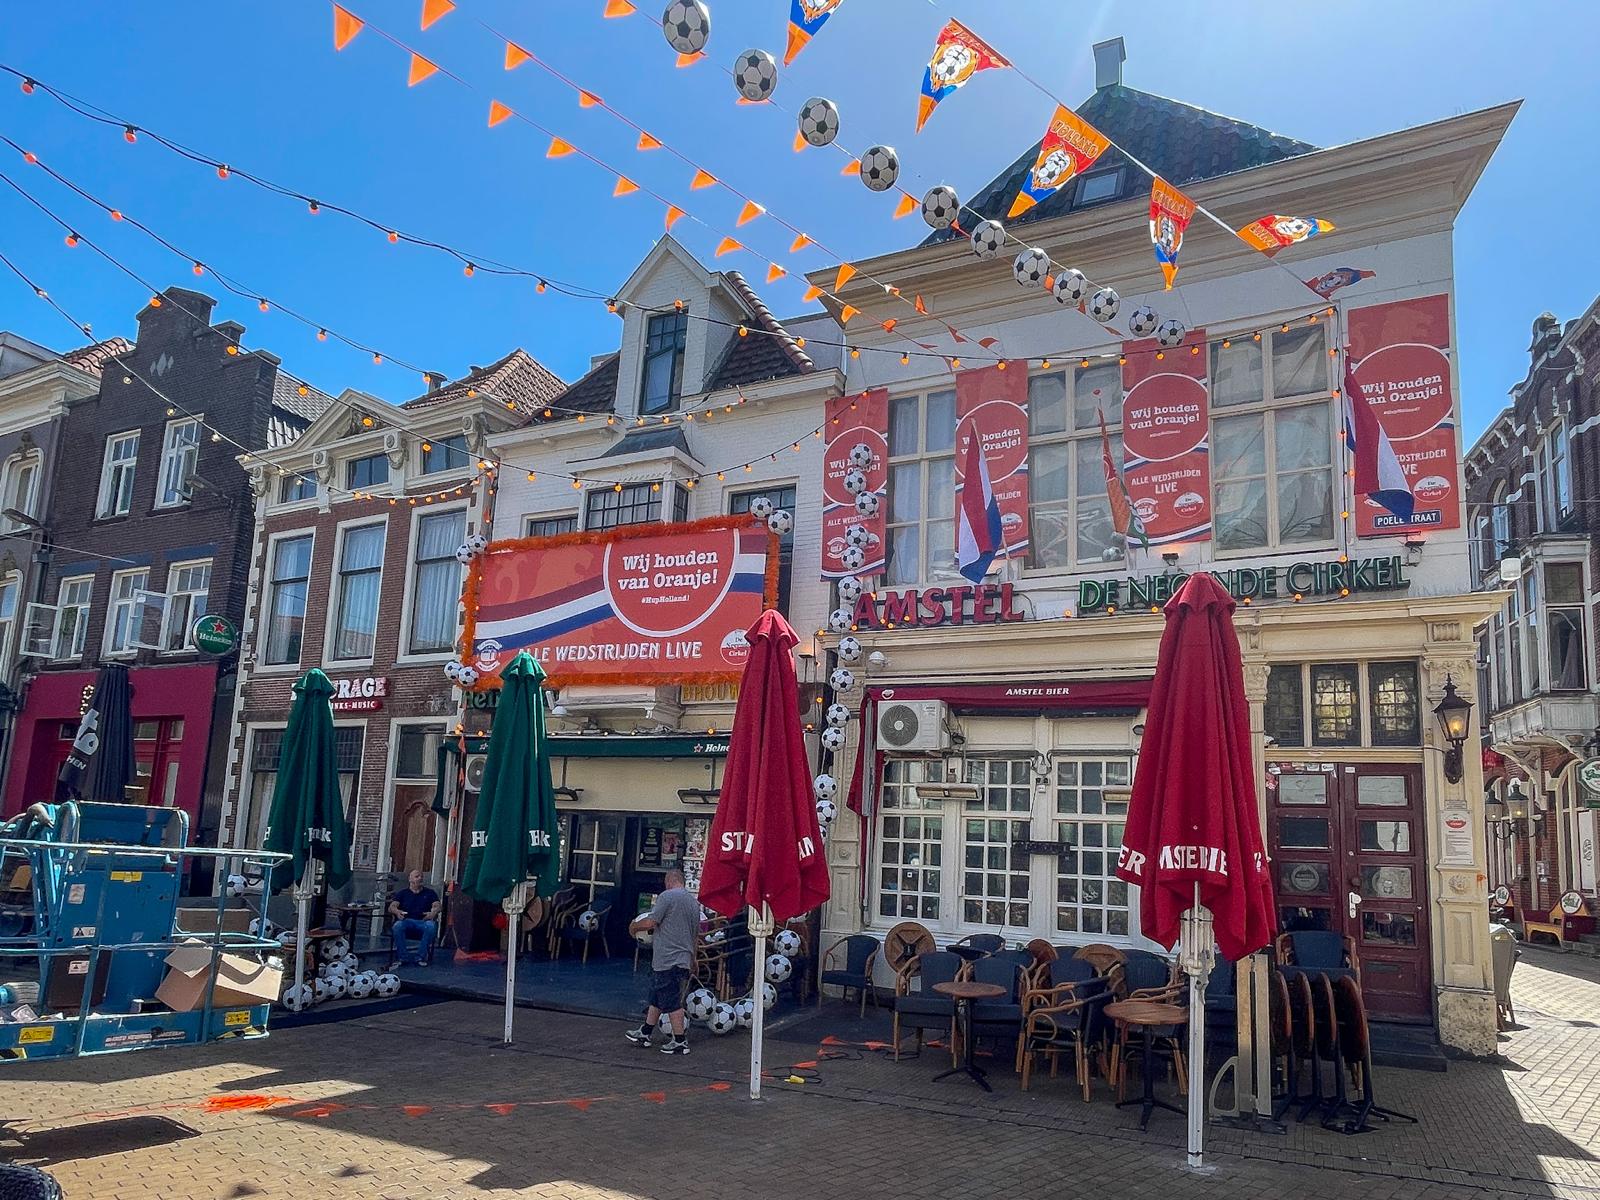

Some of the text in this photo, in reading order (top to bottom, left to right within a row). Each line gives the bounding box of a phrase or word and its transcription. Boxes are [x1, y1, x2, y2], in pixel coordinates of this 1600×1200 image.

[1360, 375, 1442, 394] Wij houden
[1390, 385, 1443, 402] Oranje!
[1130, 404, 1200, 419] Wij houden
[1129, 412, 1200, 430] van Oranje!
[981, 428, 1021, 442] houden
[982, 437, 1021, 451] Oranje!
[1397, 449, 1447, 462] DSTRIJDEN
[1402, 463, 1418, 475] VE
[1131, 469, 1201, 486] ALLE WEDSTRIJDEN
[1155, 481, 1178, 494] LIVE
[827, 519, 842, 527] ALLE
[1377, 512, 1437, 526] POELTRAAT
[623, 550, 718, 573] Wij houden
[618, 568, 718, 590] van Oranje!
[1079, 555, 1411, 609] DE NENDE CIRKEL
[851, 582, 1025, 631] AMSTEL
[555, 642, 661, 662] WEDSTRIJDEN
[665, 641, 703, 659] LIVE
[1005, 687, 1070, 696] AMSTEL BIER
[331, 700, 375, 710] NKS-MUSIC
